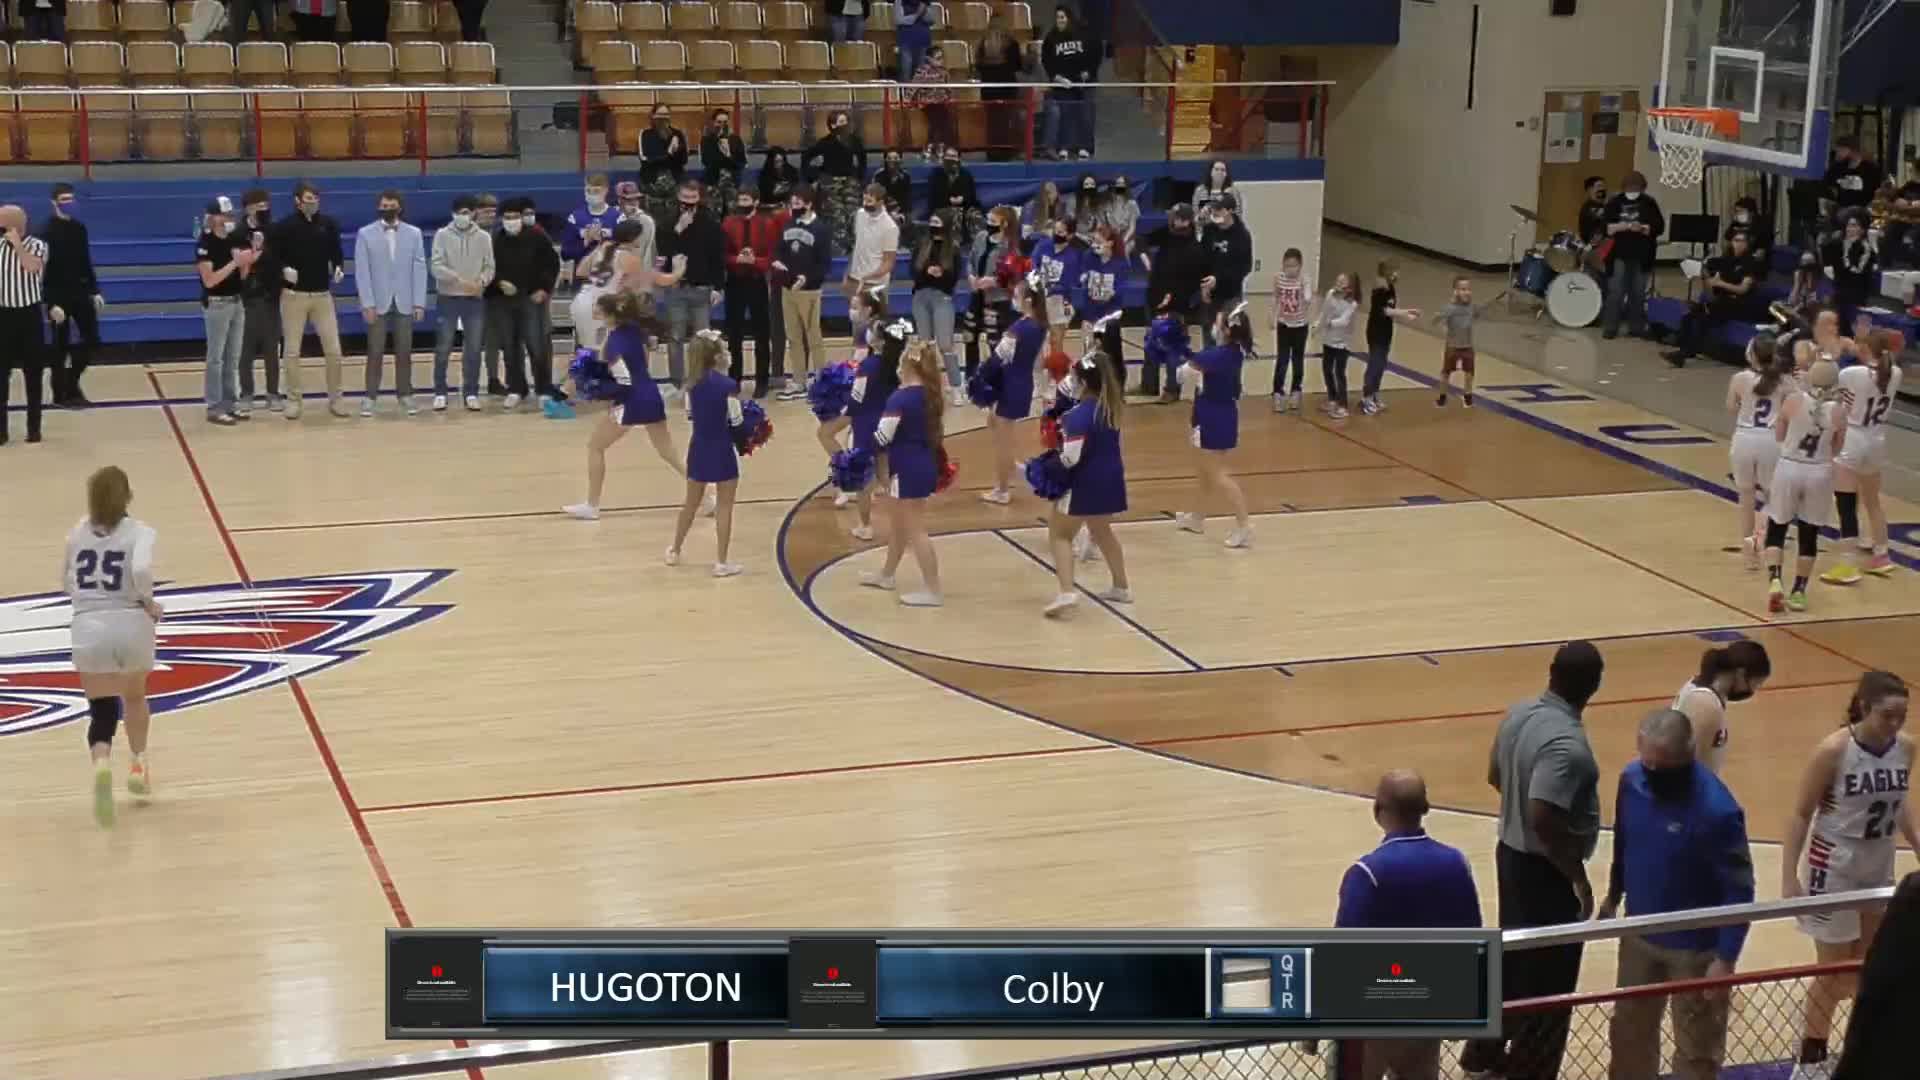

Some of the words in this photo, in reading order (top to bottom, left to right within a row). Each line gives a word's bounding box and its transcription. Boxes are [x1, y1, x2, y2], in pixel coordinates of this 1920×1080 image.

[1754, 399, 1771, 428] 2
[1863, 396, 1891, 426] 12
[1799, 433, 1821, 458] 4
[76, 549, 125, 591] 25
[1844, 768, 1909, 797] EAGLE
